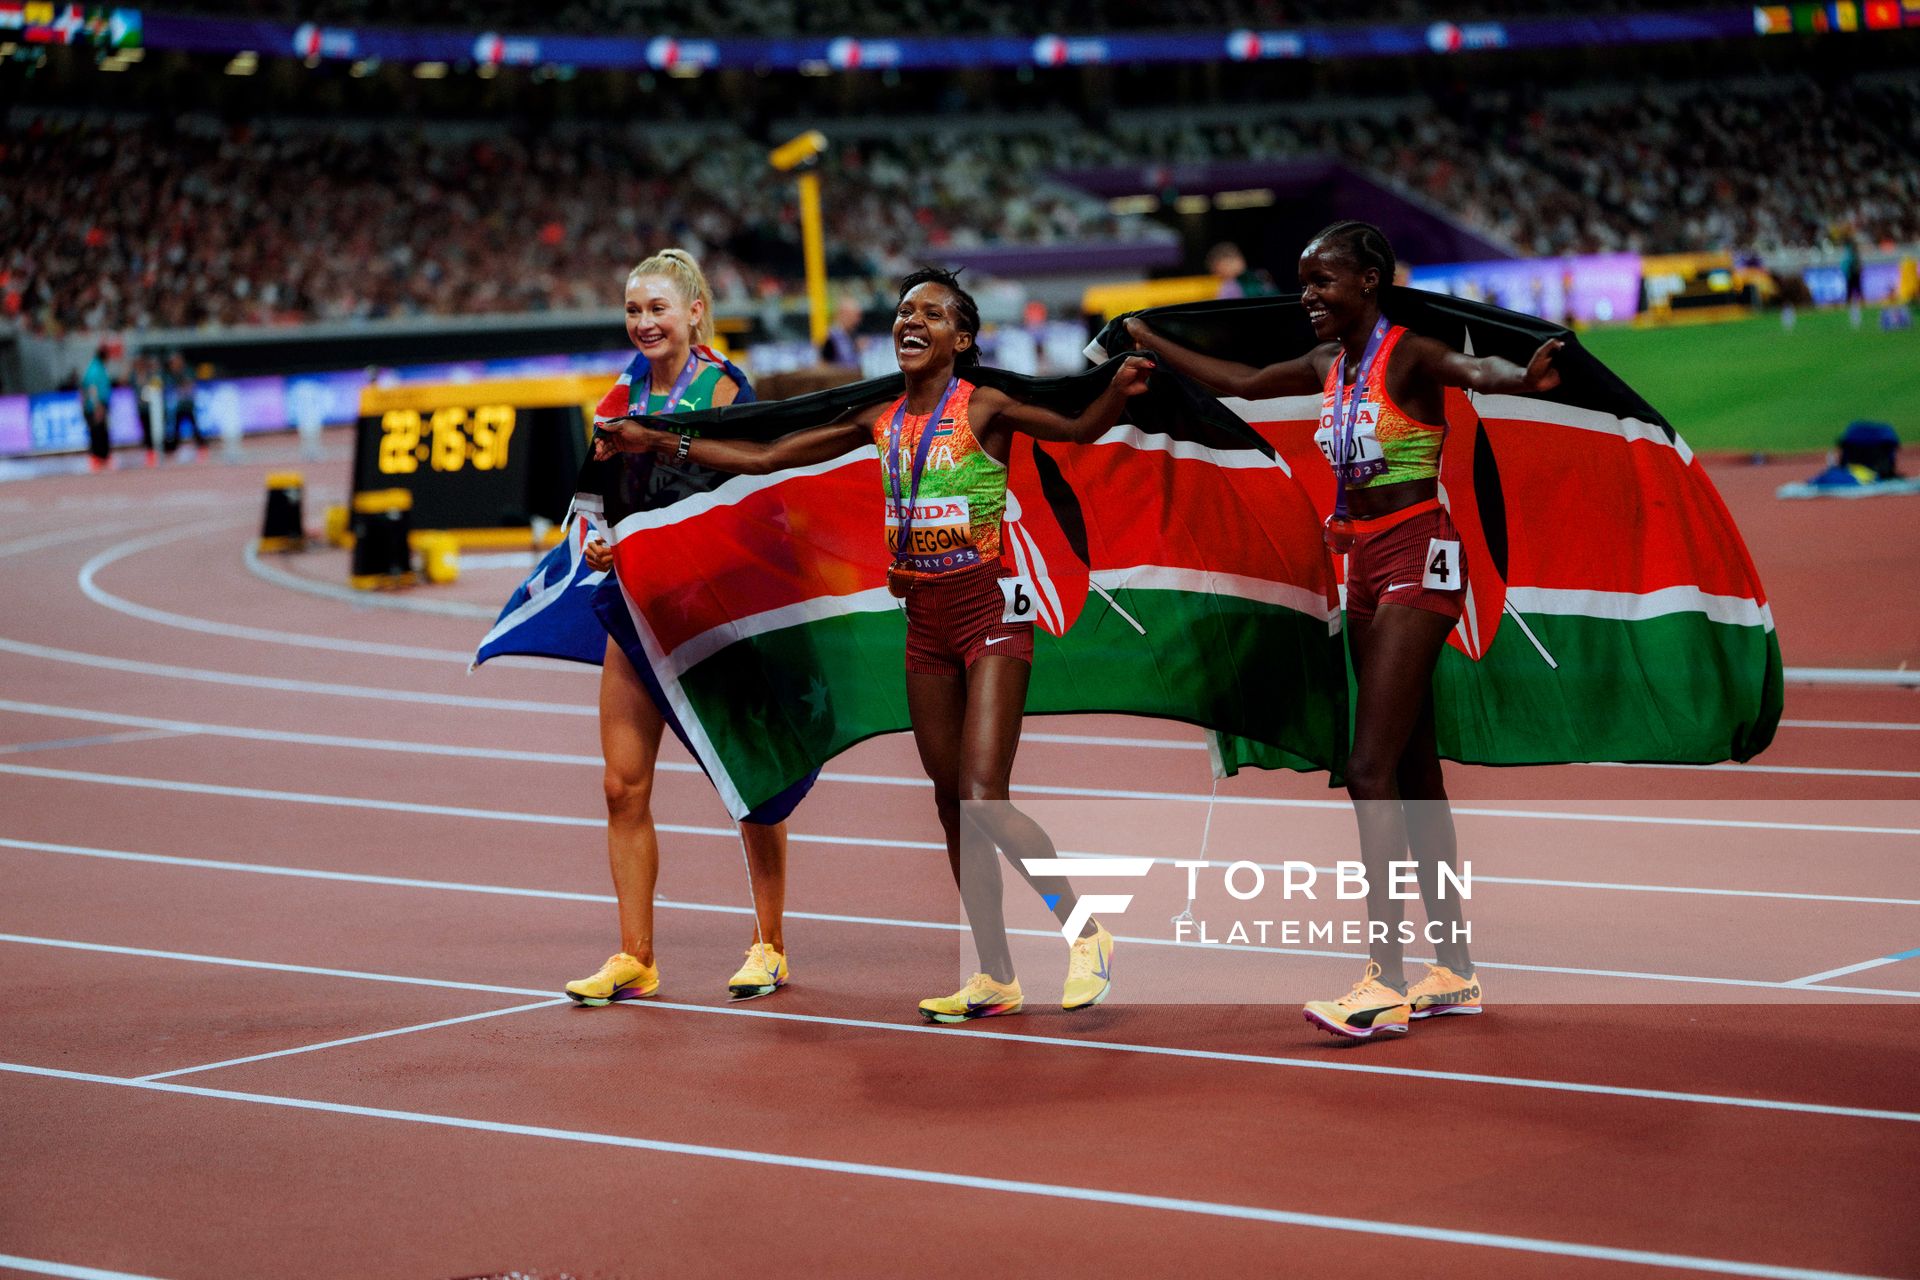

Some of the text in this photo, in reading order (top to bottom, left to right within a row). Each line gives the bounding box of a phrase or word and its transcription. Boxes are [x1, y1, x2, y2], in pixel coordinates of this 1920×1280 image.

[1319, 410, 1375, 429] ONA
[881, 445, 956, 473] KNYA
[886, 504, 966, 520] HONDA
[888, 527, 969, 552] KIYEGON
[1429, 549, 1450, 583] 4
[1014, 583, 1031, 616] 6
[1437, 985, 1480, 1004] NITRO
